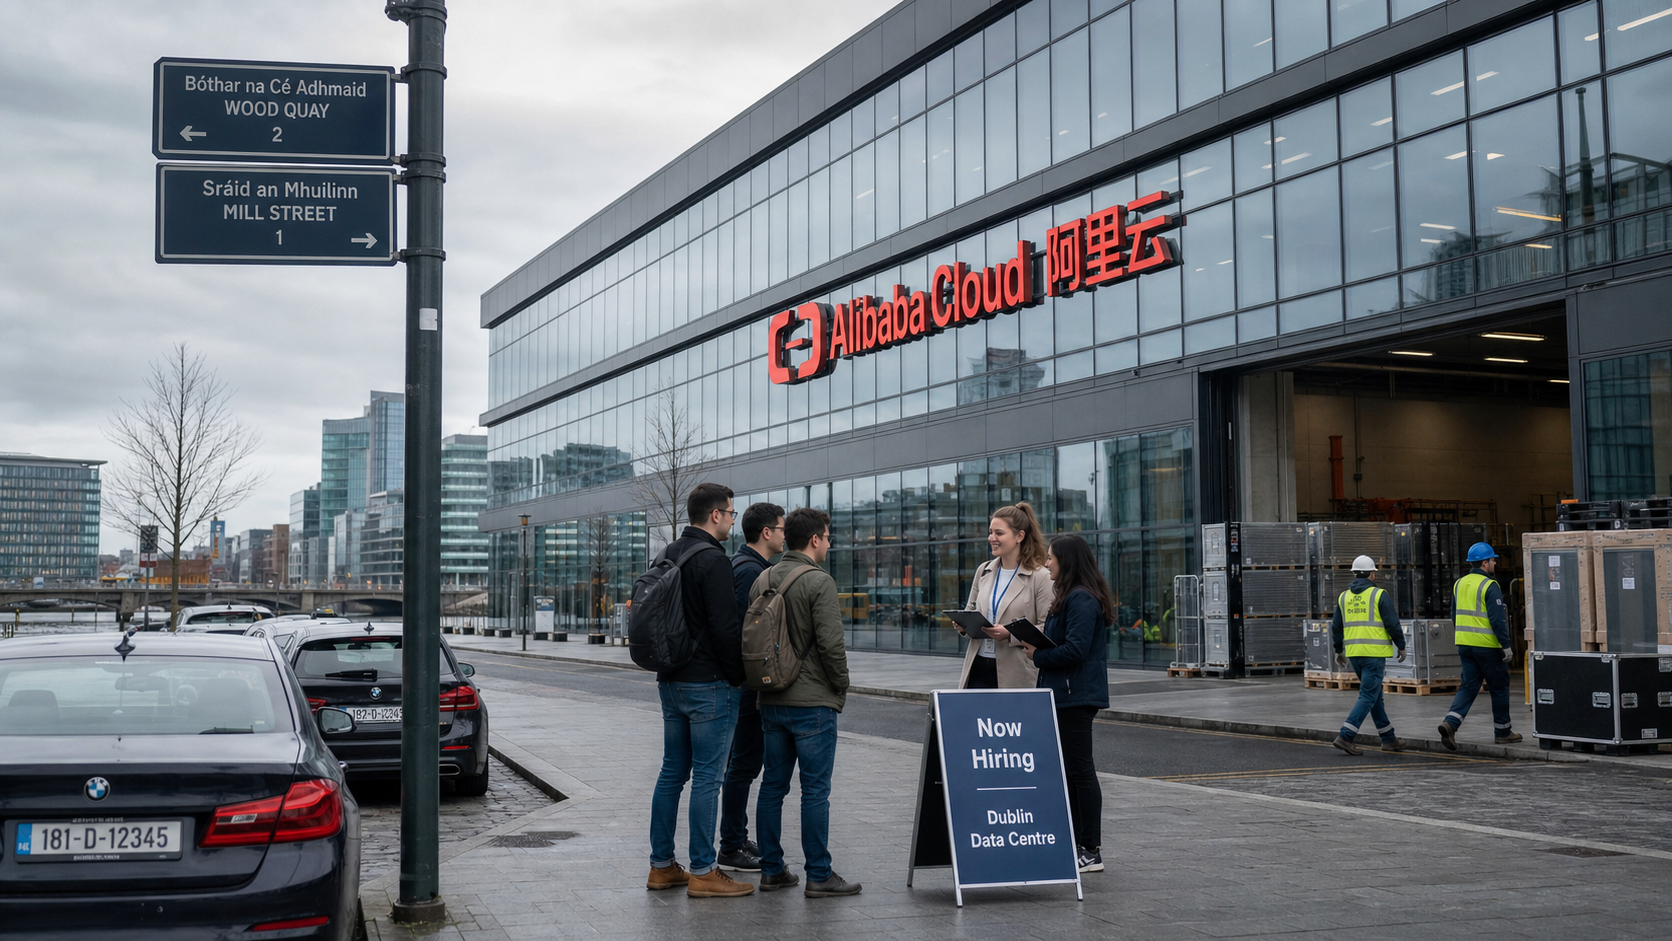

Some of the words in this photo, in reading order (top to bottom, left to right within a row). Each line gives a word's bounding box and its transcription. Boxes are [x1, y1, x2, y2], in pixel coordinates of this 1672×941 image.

[185, 75, 240, 92] Bóthar
[246, 81, 265, 93] na
[270, 78, 291, 94] Cé
[296, 80, 366, 97] Adhmaid
[225, 100, 279, 117] WOOD
[284, 102, 330, 119] QUAY
[272, 127, 282, 142] 2
[203, 180, 250, 197] Sráid
[256, 184, 278, 197] an
[285, 182, 358, 199] Mhuilinn
[223, 204, 264, 220] MILL
[269, 205, 337, 221] STREET
[275, 230, 283, 245] 1
[1046, 190, 1176, 297] 阿里云
[830, 284, 930, 360] Alibaba
[931, 240, 1033, 328] Cloud
[977, 718, 1022, 738] Now
[971, 748, 1035, 773] Hiring
[987, 808, 1034, 825] Dublin
[42, 826, 168, 850] 181-D-12345
[970, 833, 1005, 848] Data
[1008, 831, 1056, 846] Centre
